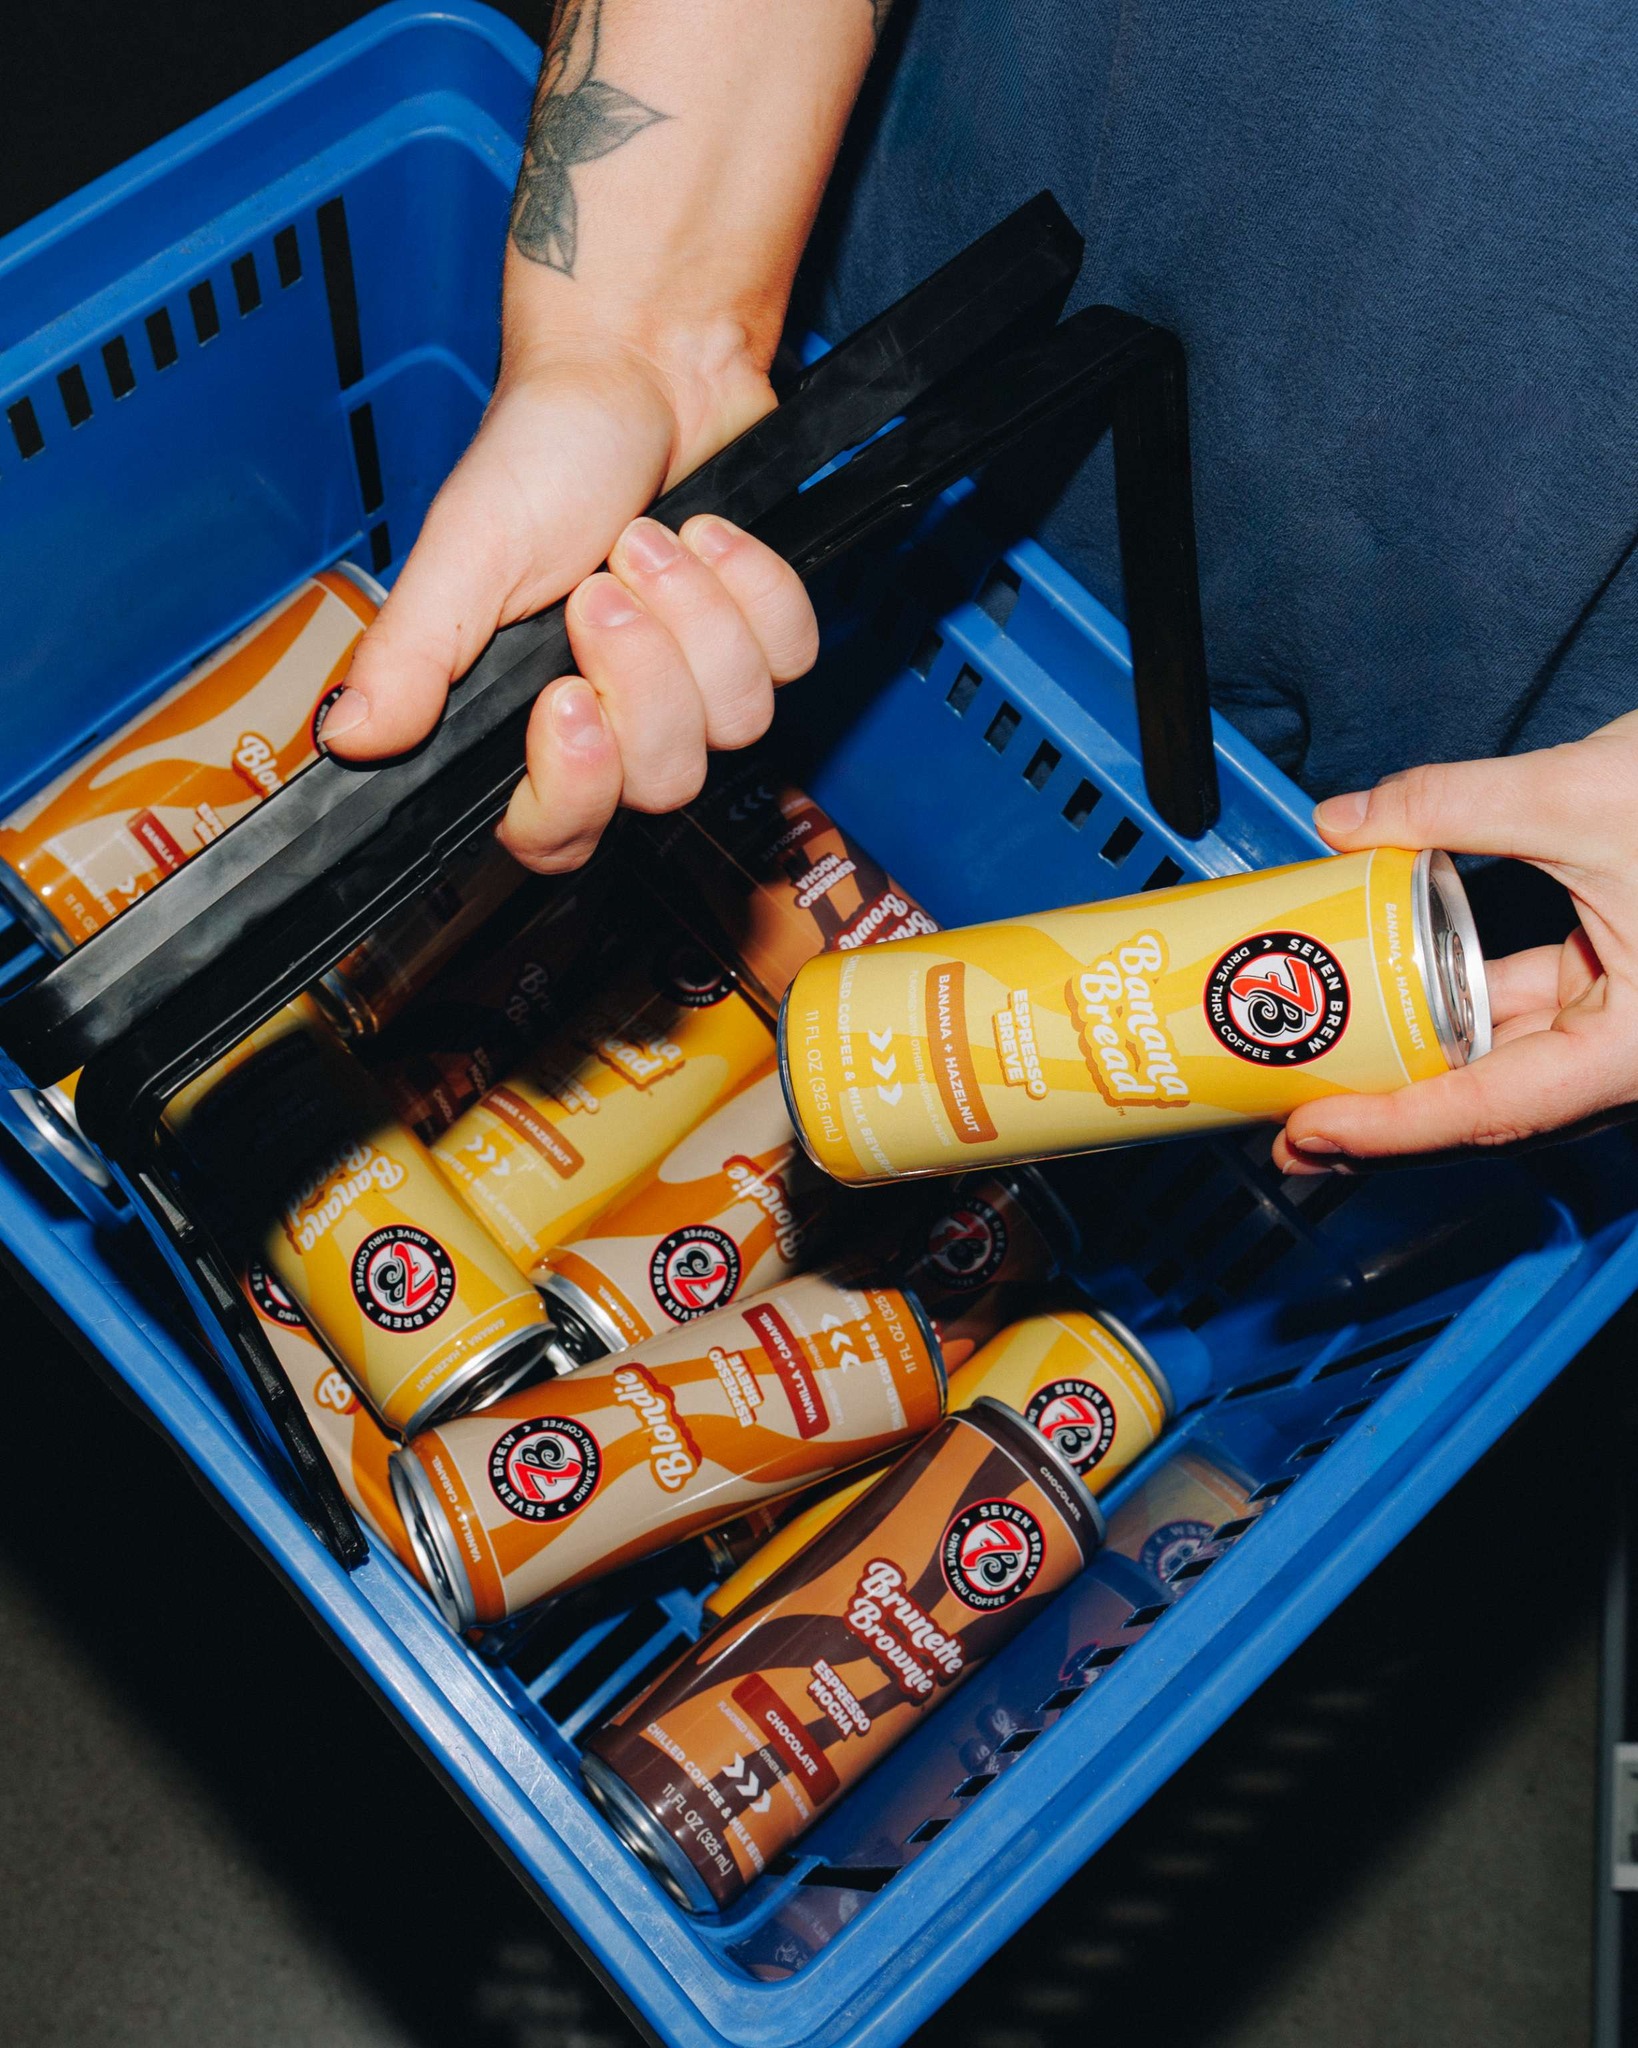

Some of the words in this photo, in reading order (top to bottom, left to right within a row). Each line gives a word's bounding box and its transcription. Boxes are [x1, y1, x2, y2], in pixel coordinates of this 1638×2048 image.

[796, 854, 841, 891] MOCHA
[799, 860, 857, 908] ESPRESSO
[1216, 946, 1250, 982] DRIVE
[1288, 938, 1342, 991] SEVEN
[1385, 902, 1402, 961] BANANA
[1396, 976, 1425, 1050] HAZELNUT
[806, 1010, 819, 1022] 11
[938, 974, 953, 1040] BANANA
[1080, 961, 1156, 1095] Bread
[1119, 934, 1188, 1097] Banana
[1211, 985, 1226, 1023] THRU
[1307, 1000, 1344, 1054] BREW
[806, 1025, 820, 1046] FL
[838, 1003, 854, 1066] COFFEE
[997, 1011, 1024, 1081] BREVE
[1013, 989, 1047, 1095] ESPRESSO
[1220, 1025, 1271, 1060] COFFEE
[808, 1049, 823, 1073] OZ
[844, 1071, 856, 1082] &
[809, 1077, 832, 1112] (325
[848, 1086, 867, 1124] MILK
[945, 1057, 980, 1133] HAZELNUT
[523, 1118, 573, 1167] HAZELNUT
[820, 1116, 844, 1144] mL)
[298, 1156, 403, 1251] Banana
[727, 1166, 803, 1258] Blondie
[367, 1230, 395, 1250] THRU
[397, 1229, 428, 1245] DRIVE
[682, 1229, 721, 1242] COFFEE
[720, 1240, 737, 1265] THRU
[355, 1249, 370, 1294] COFFEE
[426, 1267, 452, 1316] SEVEN
[653, 1251, 667, 1296] BREW
[724, 1266, 738, 1296] DRIVE
[378, 1313, 424, 1328] BREW
[873, 1295, 899, 1321] (325
[888, 1322, 905, 1342] OZ
[758, 1311, 792, 1360] CARAMEL
[865, 1333, 891, 1384] COFFEE
[899, 1343, 913, 1361] FL
[709, 1350, 753, 1428] ESPRESSO
[727, 1354, 761, 1409] BREVE
[905, 1361, 918, 1374] 11
[791, 1369, 818, 1424] VANILLA
[1054, 1382, 1104, 1405] SEVEN
[1099, 1406, 1115, 1452] BREW
[541, 1420, 583, 1438] COFFEE
[580, 1438, 596, 1467] THRU
[615, 1371, 692, 1489] Blondie
[432, 1455, 458, 1503] CARAMEL
[493, 1434, 516, 1477] BREW
[497, 1482, 546, 1517] SEVEN
[573, 1470, 596, 1502] DRIVE
[1040, 1466, 1081, 1522] CHOCOLATE
[455, 1512, 482, 1563] VANILLA
[947, 1532, 960, 1567] DRIVE
[979, 1504, 1032, 1529] SEVEN
[1025, 1531, 1042, 1580] BREW
[950, 1568, 970, 1596] THRU
[968, 1593, 1006, 1606] COFFEE
[860, 1561, 963, 1675] Brunette
[848, 1596, 934, 1694] Brownie
[809, 1680, 853, 1736] MOCHA
[812, 1659, 871, 1733] ESPRESSO
[759, 1748, 780, 1774] OTHER
[765, 1709, 818, 1776] CHOCOLATE
[646, 1722, 685, 1761] CHILLED
[684, 1761, 725, 1809] COFFEE
[721, 1807, 733, 1819] &
[728, 1816, 751, 1845] MILK
[746, 1843, 764, 1874] BEVE
[662, 1783, 676, 1798] 11
[671, 1794, 687, 1815] FL
[684, 1810, 704, 1832] OZ
[695, 1827, 722, 1857] (325
[714, 1853, 734, 1878] mL)
